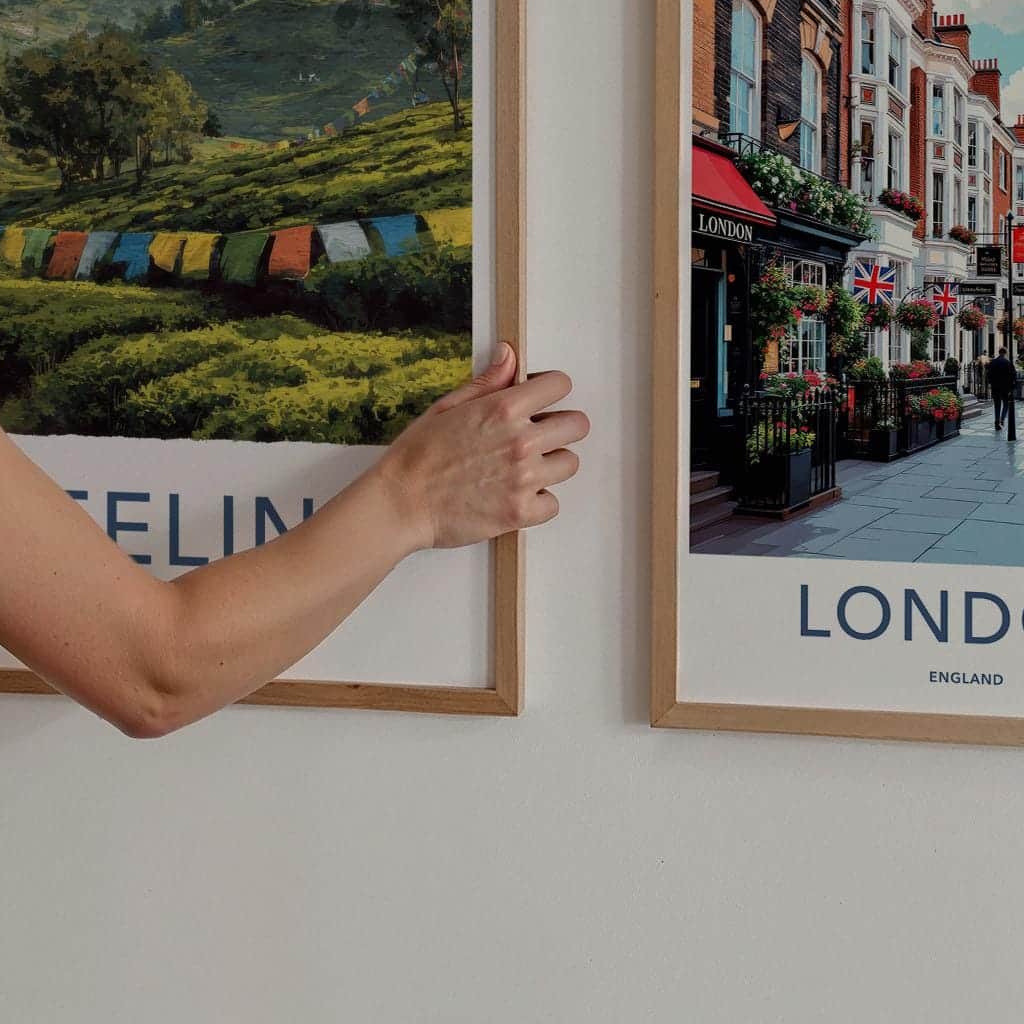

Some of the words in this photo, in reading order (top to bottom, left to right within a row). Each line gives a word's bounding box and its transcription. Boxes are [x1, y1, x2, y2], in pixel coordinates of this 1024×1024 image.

[698, 213, 753, 242] LONDON
[66, 490, 314, 566] ELIN
[800, 584, 1024, 645] LOND
[929, 670, 1004, 686] ENGLAND
